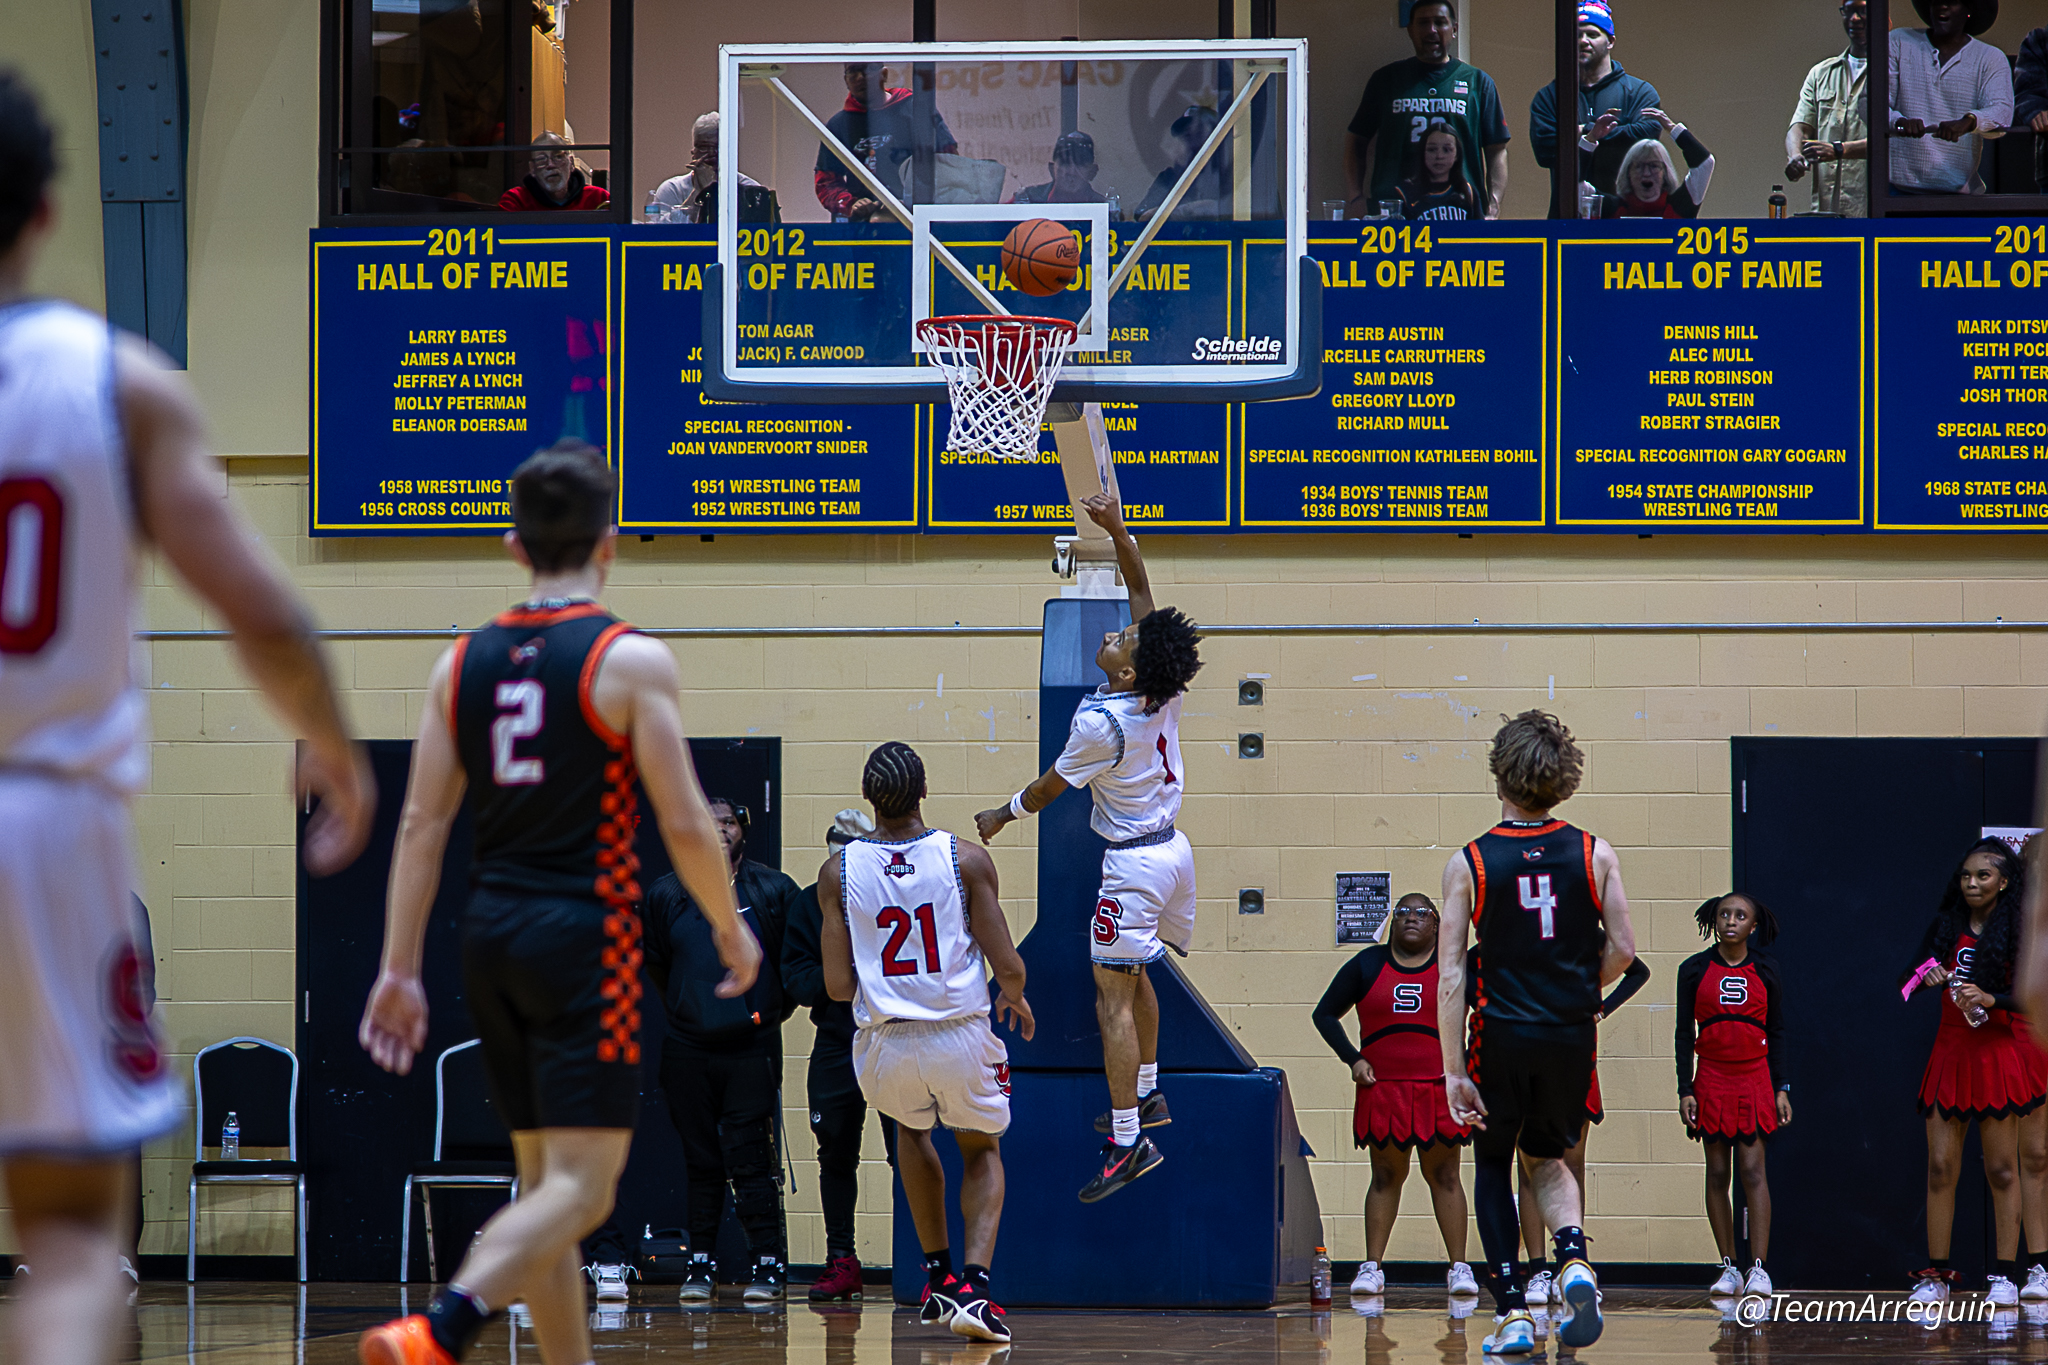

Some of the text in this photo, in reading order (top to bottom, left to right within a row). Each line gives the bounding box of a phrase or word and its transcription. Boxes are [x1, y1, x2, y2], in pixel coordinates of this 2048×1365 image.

[1392, 97, 1467, 115] SPARTANS
[429, 228, 493, 255] 2011
[738, 229, 804, 256] 2012
[1362, 226, 1432, 253] 2014
[1678, 227, 1748, 254] 2015
[1995, 226, 2045, 253] 201
[358, 262, 567, 290] HALL OF FAME
[749, 264, 785, 289] OF
[797, 263, 874, 289] FAME
[1376, 261, 1414, 287] OF
[1426, 261, 1504, 287] FAME
[1605, 261, 1821, 289] HALL OF FAME
[1922, 261, 2048, 287] HALL OF
[739, 325, 813, 337] TOM AGAR
[1665, 326, 1758, 339] DENNIS HILL
[1958, 320, 2001, 333] MARK
[410, 330, 506, 343] LARRY BATES
[1345, 327, 1443, 340] HERB AUSTIN
[786, 347, 795, 359] F.
[801, 347, 863, 359] CAWOOD
[1192, 336, 1282, 361] Schelde
[1670, 348, 1753, 361] ALEC MULL
[1964, 343, 2009, 356] KEITH
[401, 352, 515, 366] JAMES A LYNCH
[1078, 350, 1132, 364] MILLER
[1206, 352, 1280, 361] international
[1386, 349, 1485, 363] CARRUTHERS
[1354, 372, 1433, 385] SAM DAVIS
[1650, 371, 1772, 384] HERB ROBINSON
[1975, 366, 2014, 379] PATTI
[394, 374, 522, 388] JEFFREY A LYNCH
[1332, 394, 1455, 407] GREGORY LLOYD
[1668, 393, 1753, 406] PAUL STEIN
[1961, 389, 2000, 402] JOSH
[395, 396, 526, 410] MOLLY PETERMAN
[393, 419, 526, 431] ELEANOR DOERSAM
[685, 421, 742, 433] SPECIAL
[747, 420, 842, 433] RECOGNITION
[1338, 417, 1449, 429] RICHARD MULL
[1641, 416, 1780, 429] ROBERT STRAGIER
[1938, 423, 2001, 437] SPECIAL
[668, 441, 867, 454] JOAN VANDERVOORT SNIDER
[1959, 446, 2028, 459] CHARLES
[941, 451, 999, 464] SPECIAL
[1150, 451, 1219, 464] HARTMAN
[1250, 450, 1537, 462] SPECIAL RECOGNITION KATHLEEN BOHIL
[1576, 449, 1845, 462] SPECIAL RECOGNITION GARY GOGARN
[380, 481, 412, 493] 1958
[417, 480, 501, 493] WRESTLING
[693, 479, 860, 493] 1951 WRESTLING TEAM
[1302, 486, 1487, 499] 1934 BOYS' TENNIS TEAM
[1608, 485, 1813, 498] 1954 STATE CHAMPIONSHIP
[1926, 482, 1959, 495] 1968
[1965, 482, 2010, 495] STATE
[361, 502, 510, 515] 1956 CROSS COUNTR
[692, 502, 860, 515] 1952 WRESTLING TEAM
[995, 505, 1028, 518] 1957
[1123, 505, 1163, 518] TEAM
[1302, 504, 1487, 517] 1936 BOYS' TENNIS TEAM
[1644, 503, 1777, 516] WRESTLING TEAM
[1961, 504, 2048, 517] WRESTLING
[491, 679, 545, 785] 2
[1156, 732, 1177, 786] 1
[1519, 874, 1557, 938] 4
[1093, 896, 1123, 946] S
[876, 903, 942, 977] 21
[1720, 976, 1748, 1005] S
[1394, 984, 1422, 1013] S
